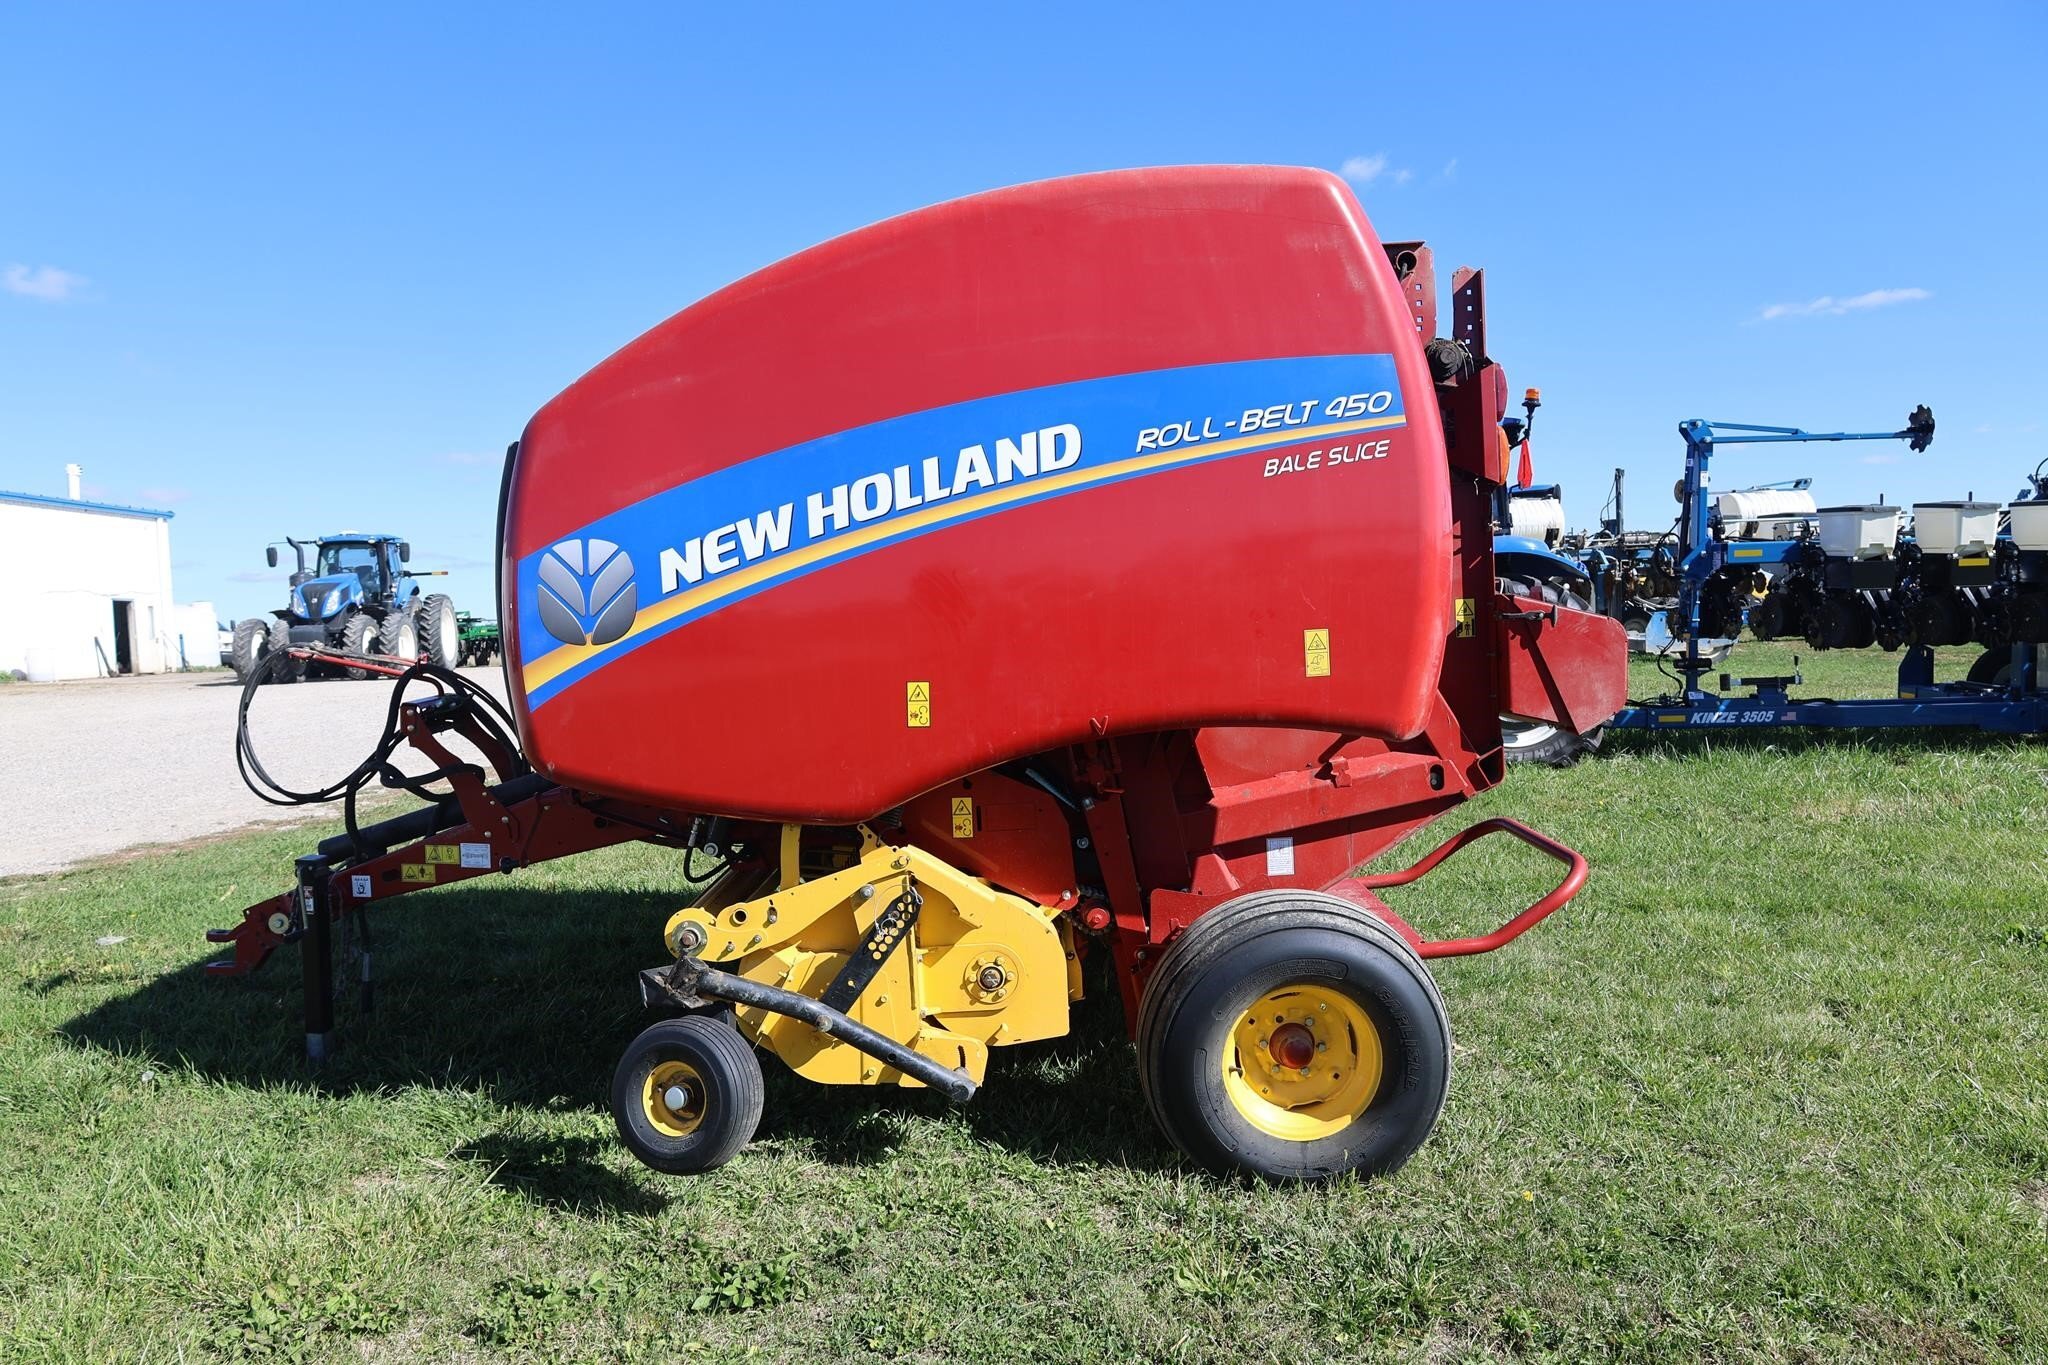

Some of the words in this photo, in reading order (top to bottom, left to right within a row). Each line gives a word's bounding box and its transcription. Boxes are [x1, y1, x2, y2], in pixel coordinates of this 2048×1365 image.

[1325, 391, 1393, 419] 450
[1264, 451, 1322, 477] BALE
[1327, 440, 1391, 467] SLICE
[660, 503, 795, 594] NEW
[807, 423, 1082, 539] HOLLAND
[1691, 711, 1739, 724] KINZE
[1740, 710, 1775, 723] 3505
